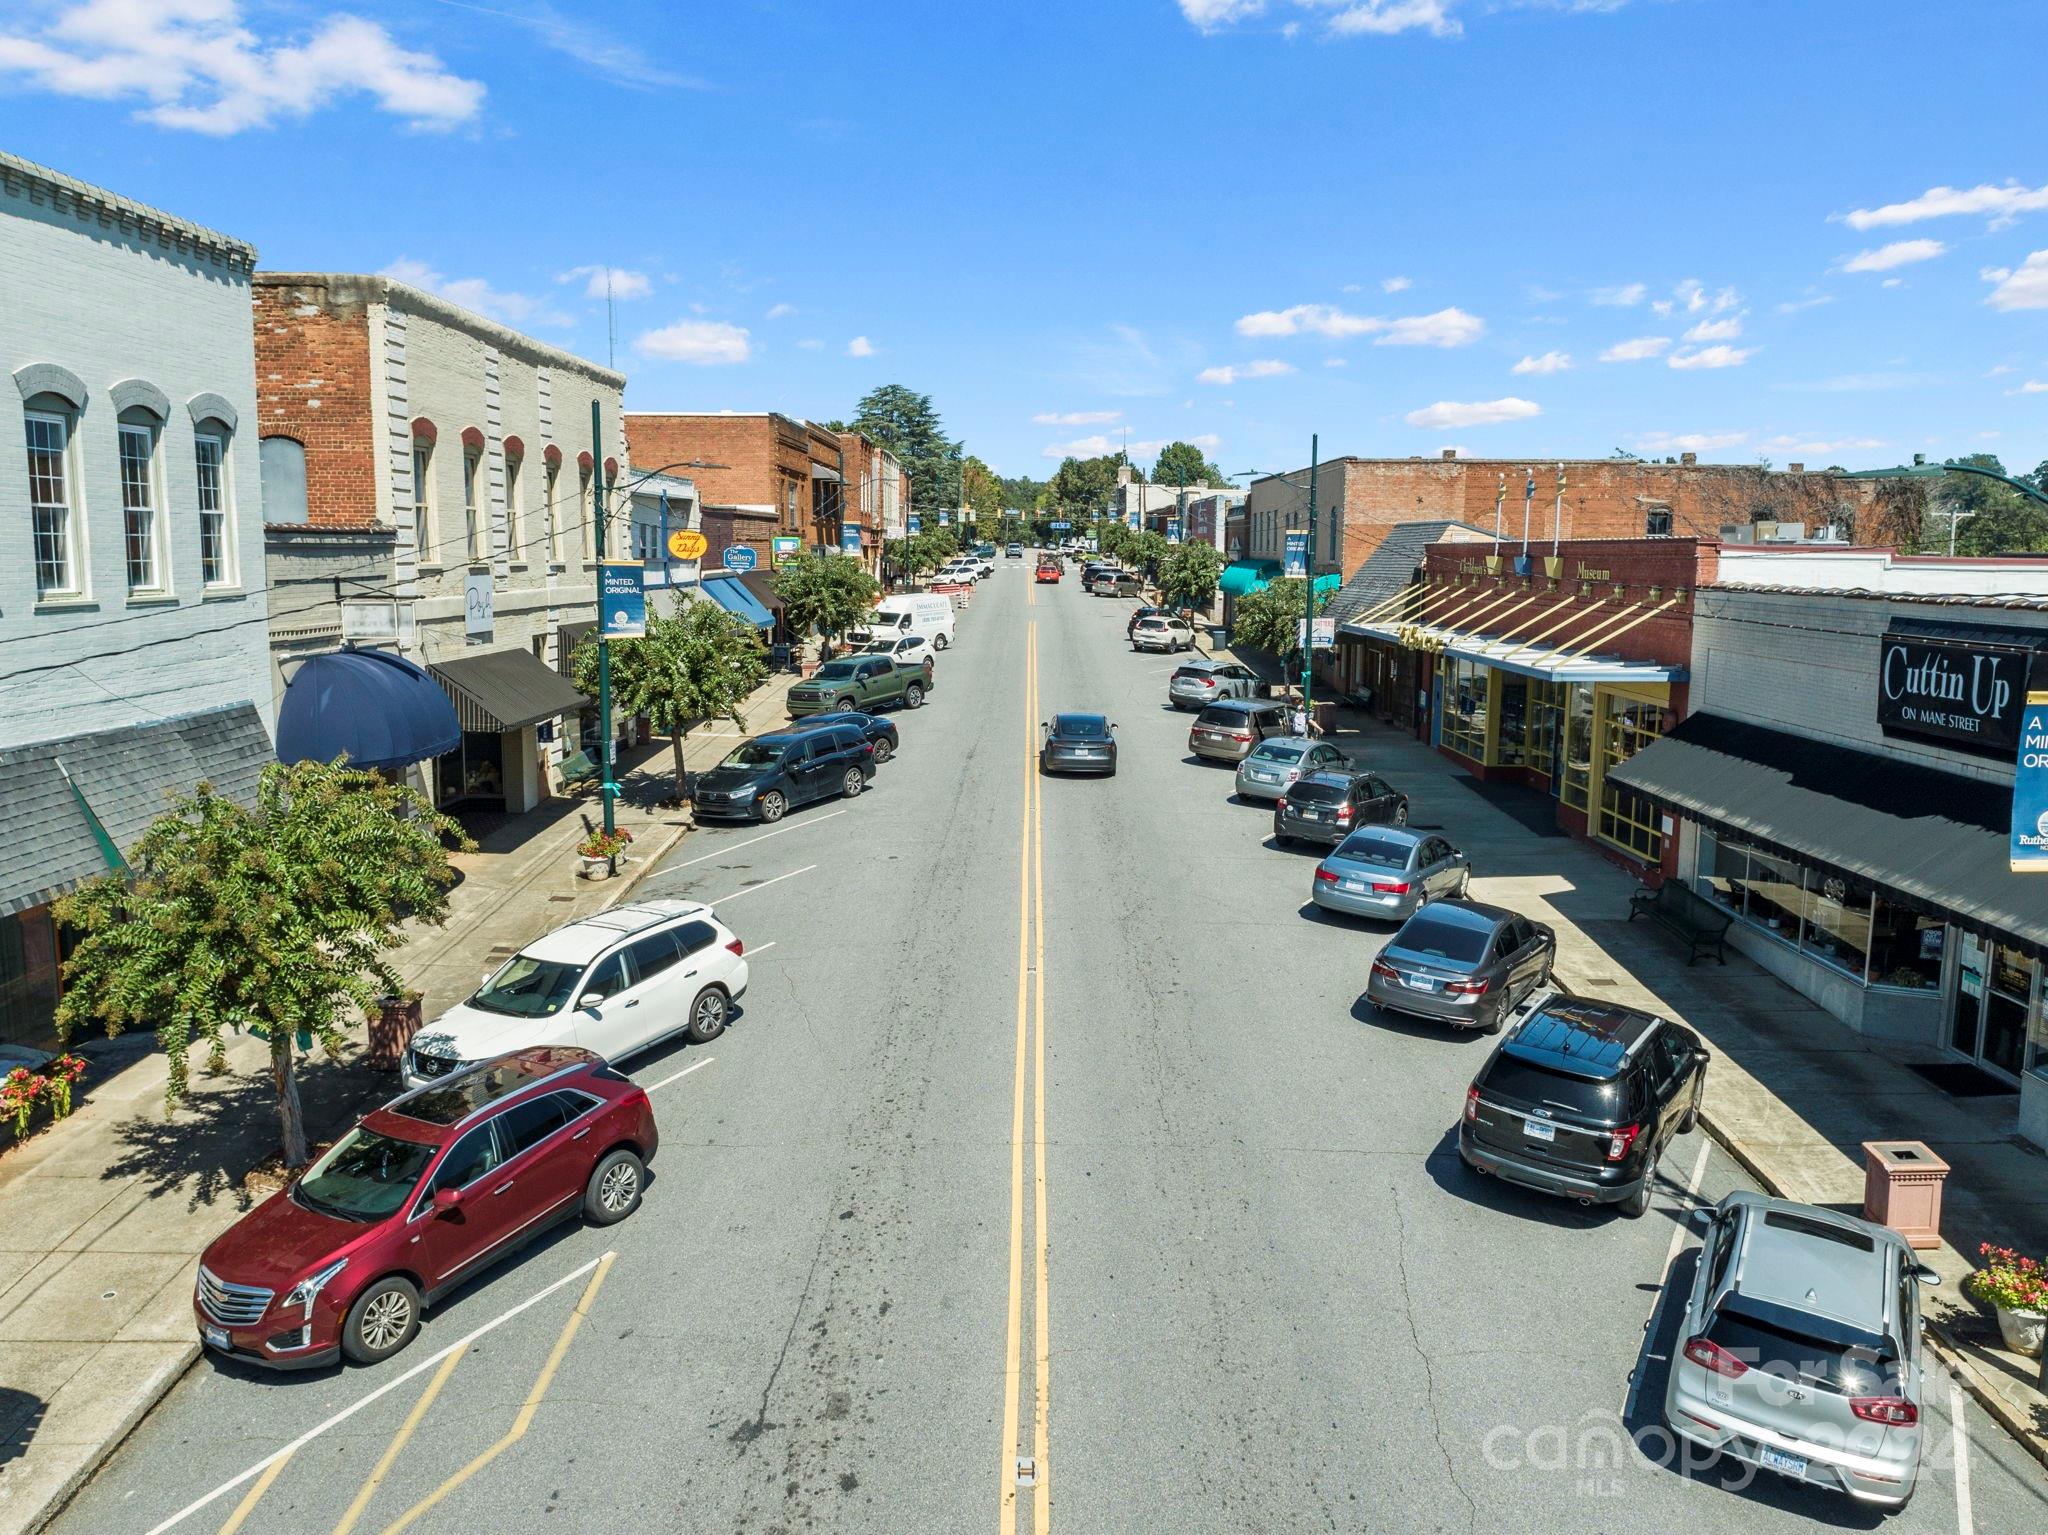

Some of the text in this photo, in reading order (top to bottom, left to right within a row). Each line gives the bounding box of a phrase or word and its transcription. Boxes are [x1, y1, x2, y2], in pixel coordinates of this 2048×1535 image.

[676, 531, 701, 548] Sunny
[676, 543, 700, 559] Days
[728, 553, 752, 561] Gallery
[1577, 561, 1610, 580] Museum
[1884, 645, 2010, 719] Cuttin Up
[1902, 706, 1981, 733] ON MANE STREET
[2028, 716, 2042, 730] A
